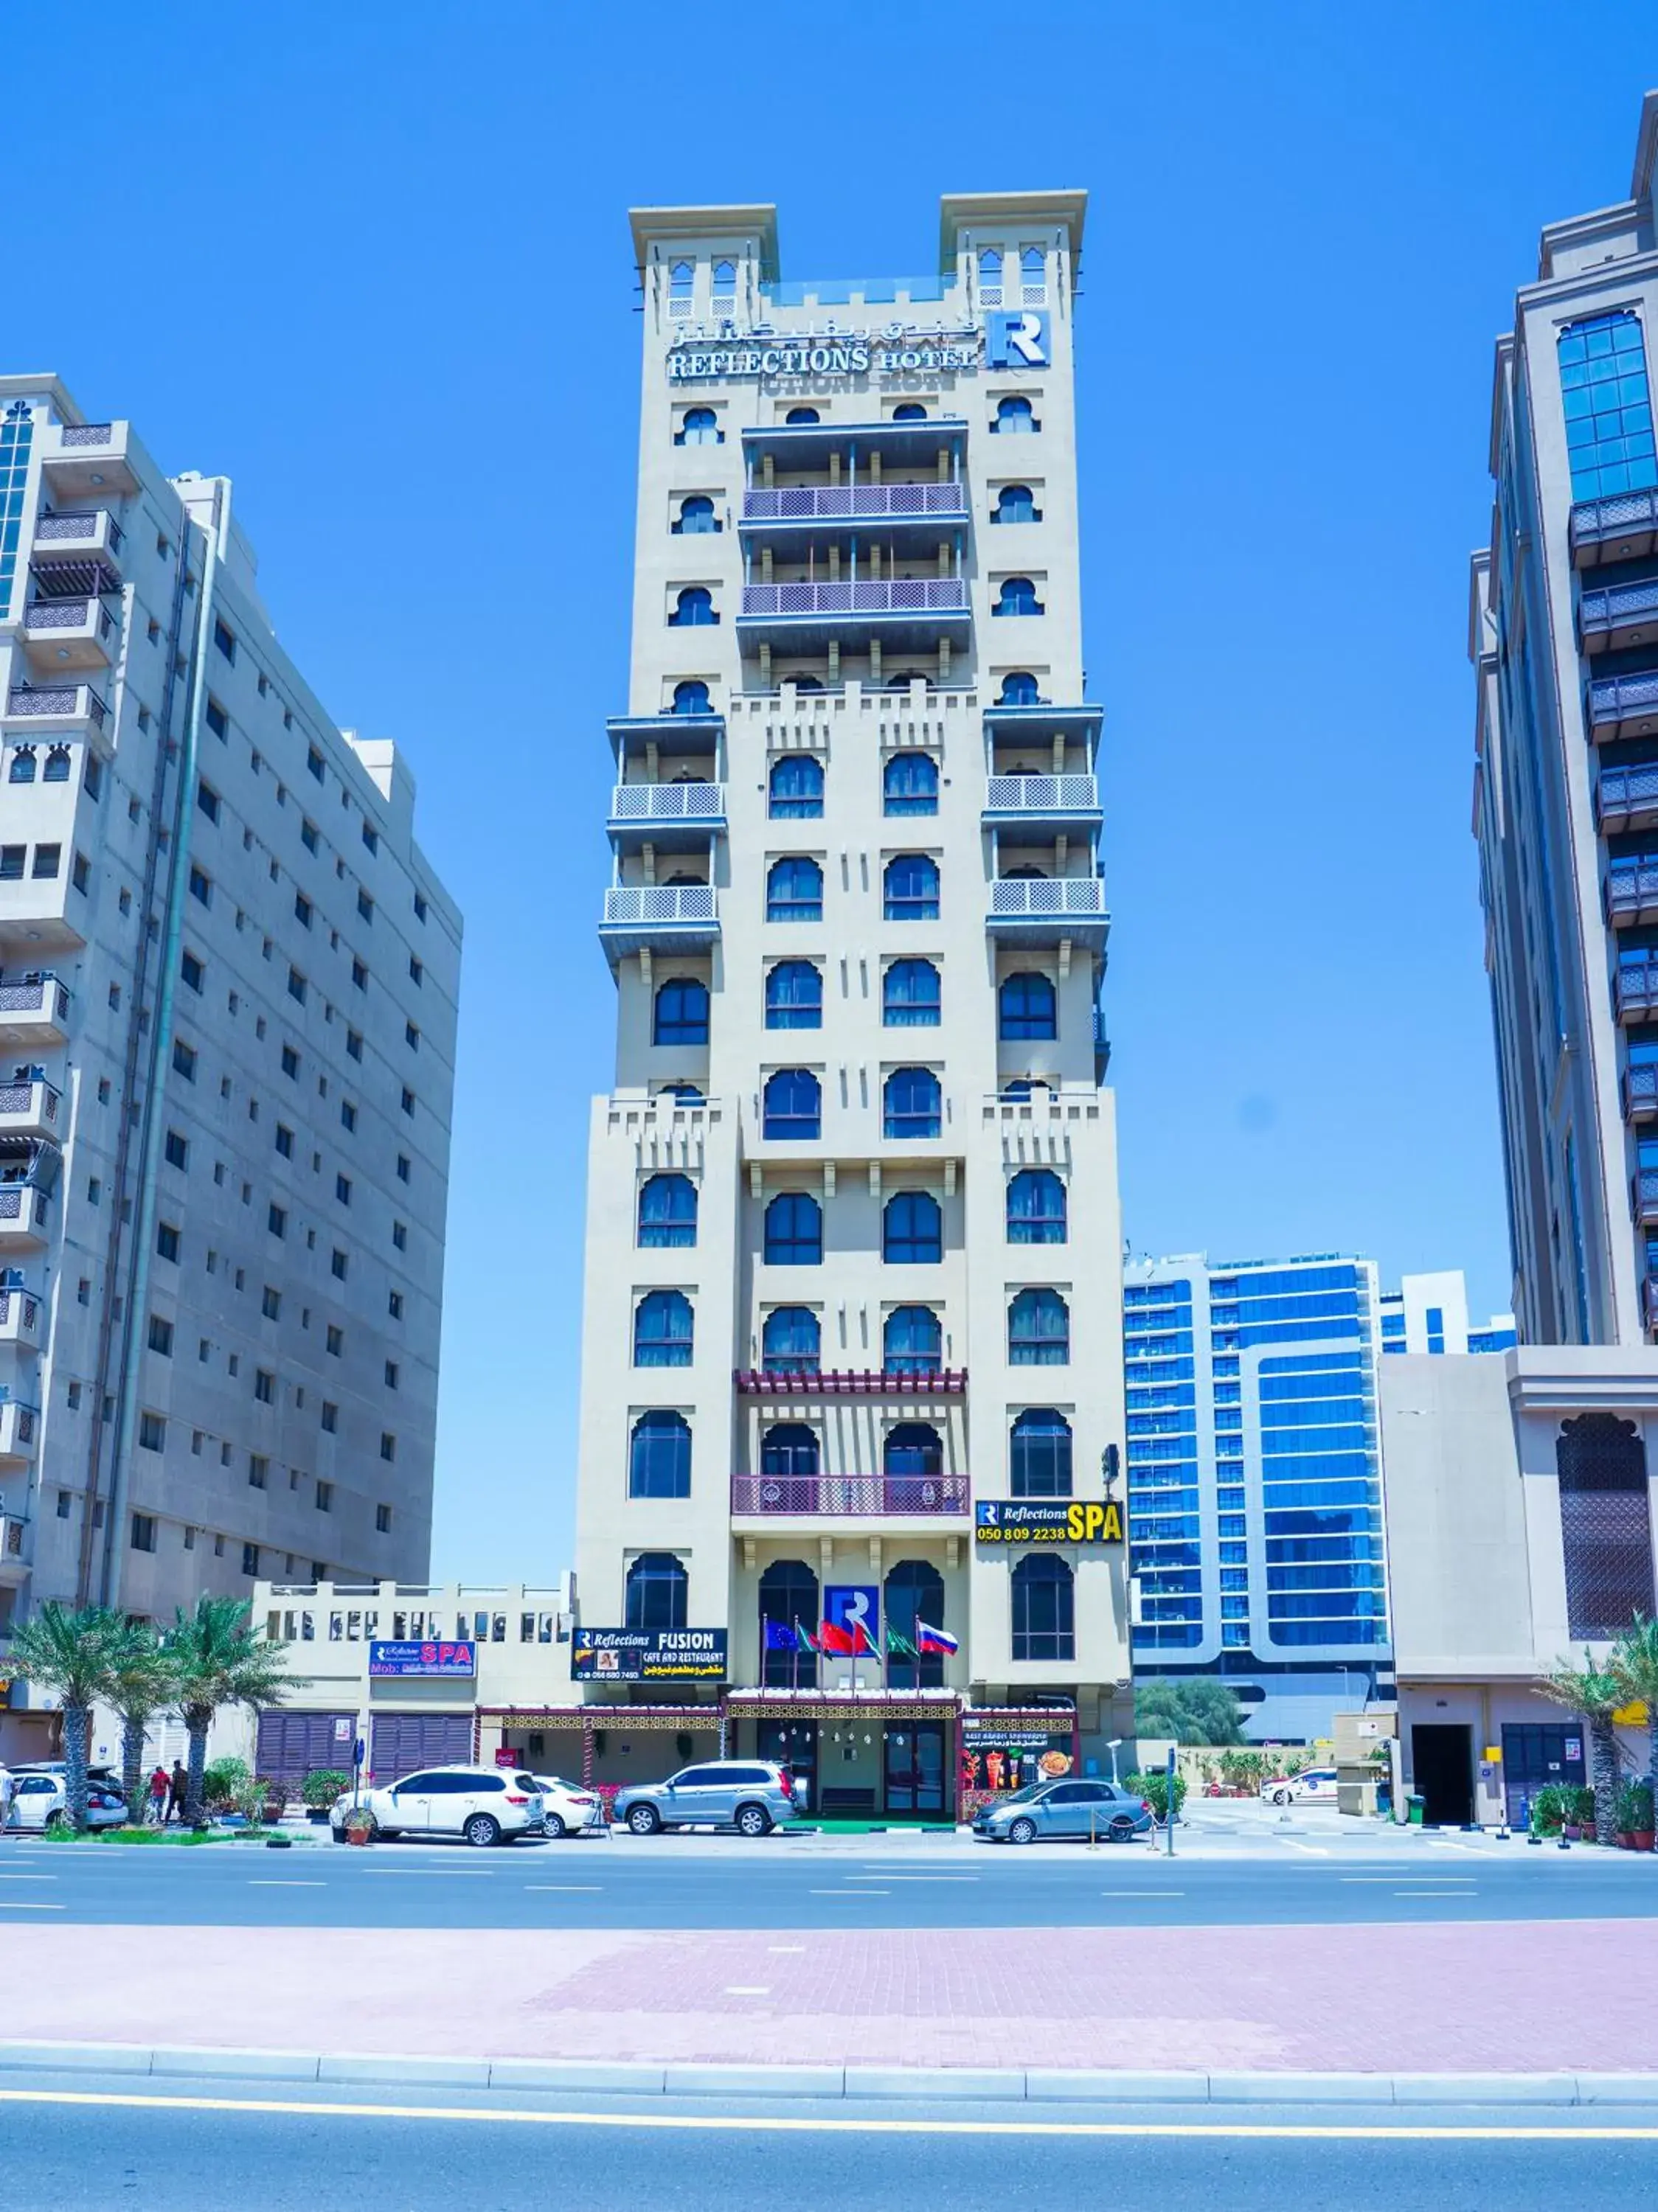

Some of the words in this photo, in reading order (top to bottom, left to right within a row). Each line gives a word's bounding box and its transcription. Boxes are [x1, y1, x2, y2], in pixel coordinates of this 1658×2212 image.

[991, 313, 1047, 366] R
[669, 347, 868, 377] REFLECTIONS
[880, 350, 978, 368] HOTEL
[1004, 1507, 1067, 1521] Reflections
[1068, 1504, 1122, 1540] SPA
[977, 1528, 1002, 1540] 050
[1004, 1528, 1030, 1540] 809
[1033, 1528, 1066, 1540] 2238
[594, 1633, 650, 1648] Reflections
[659, 1632, 714, 1651] FUSION
[421, 1644, 472, 1663] SPA
[643, 1652, 661, 1663] CAFE
[662, 1652, 677, 1663] AND
[679, 1652, 724, 1663] RESTAURANT
